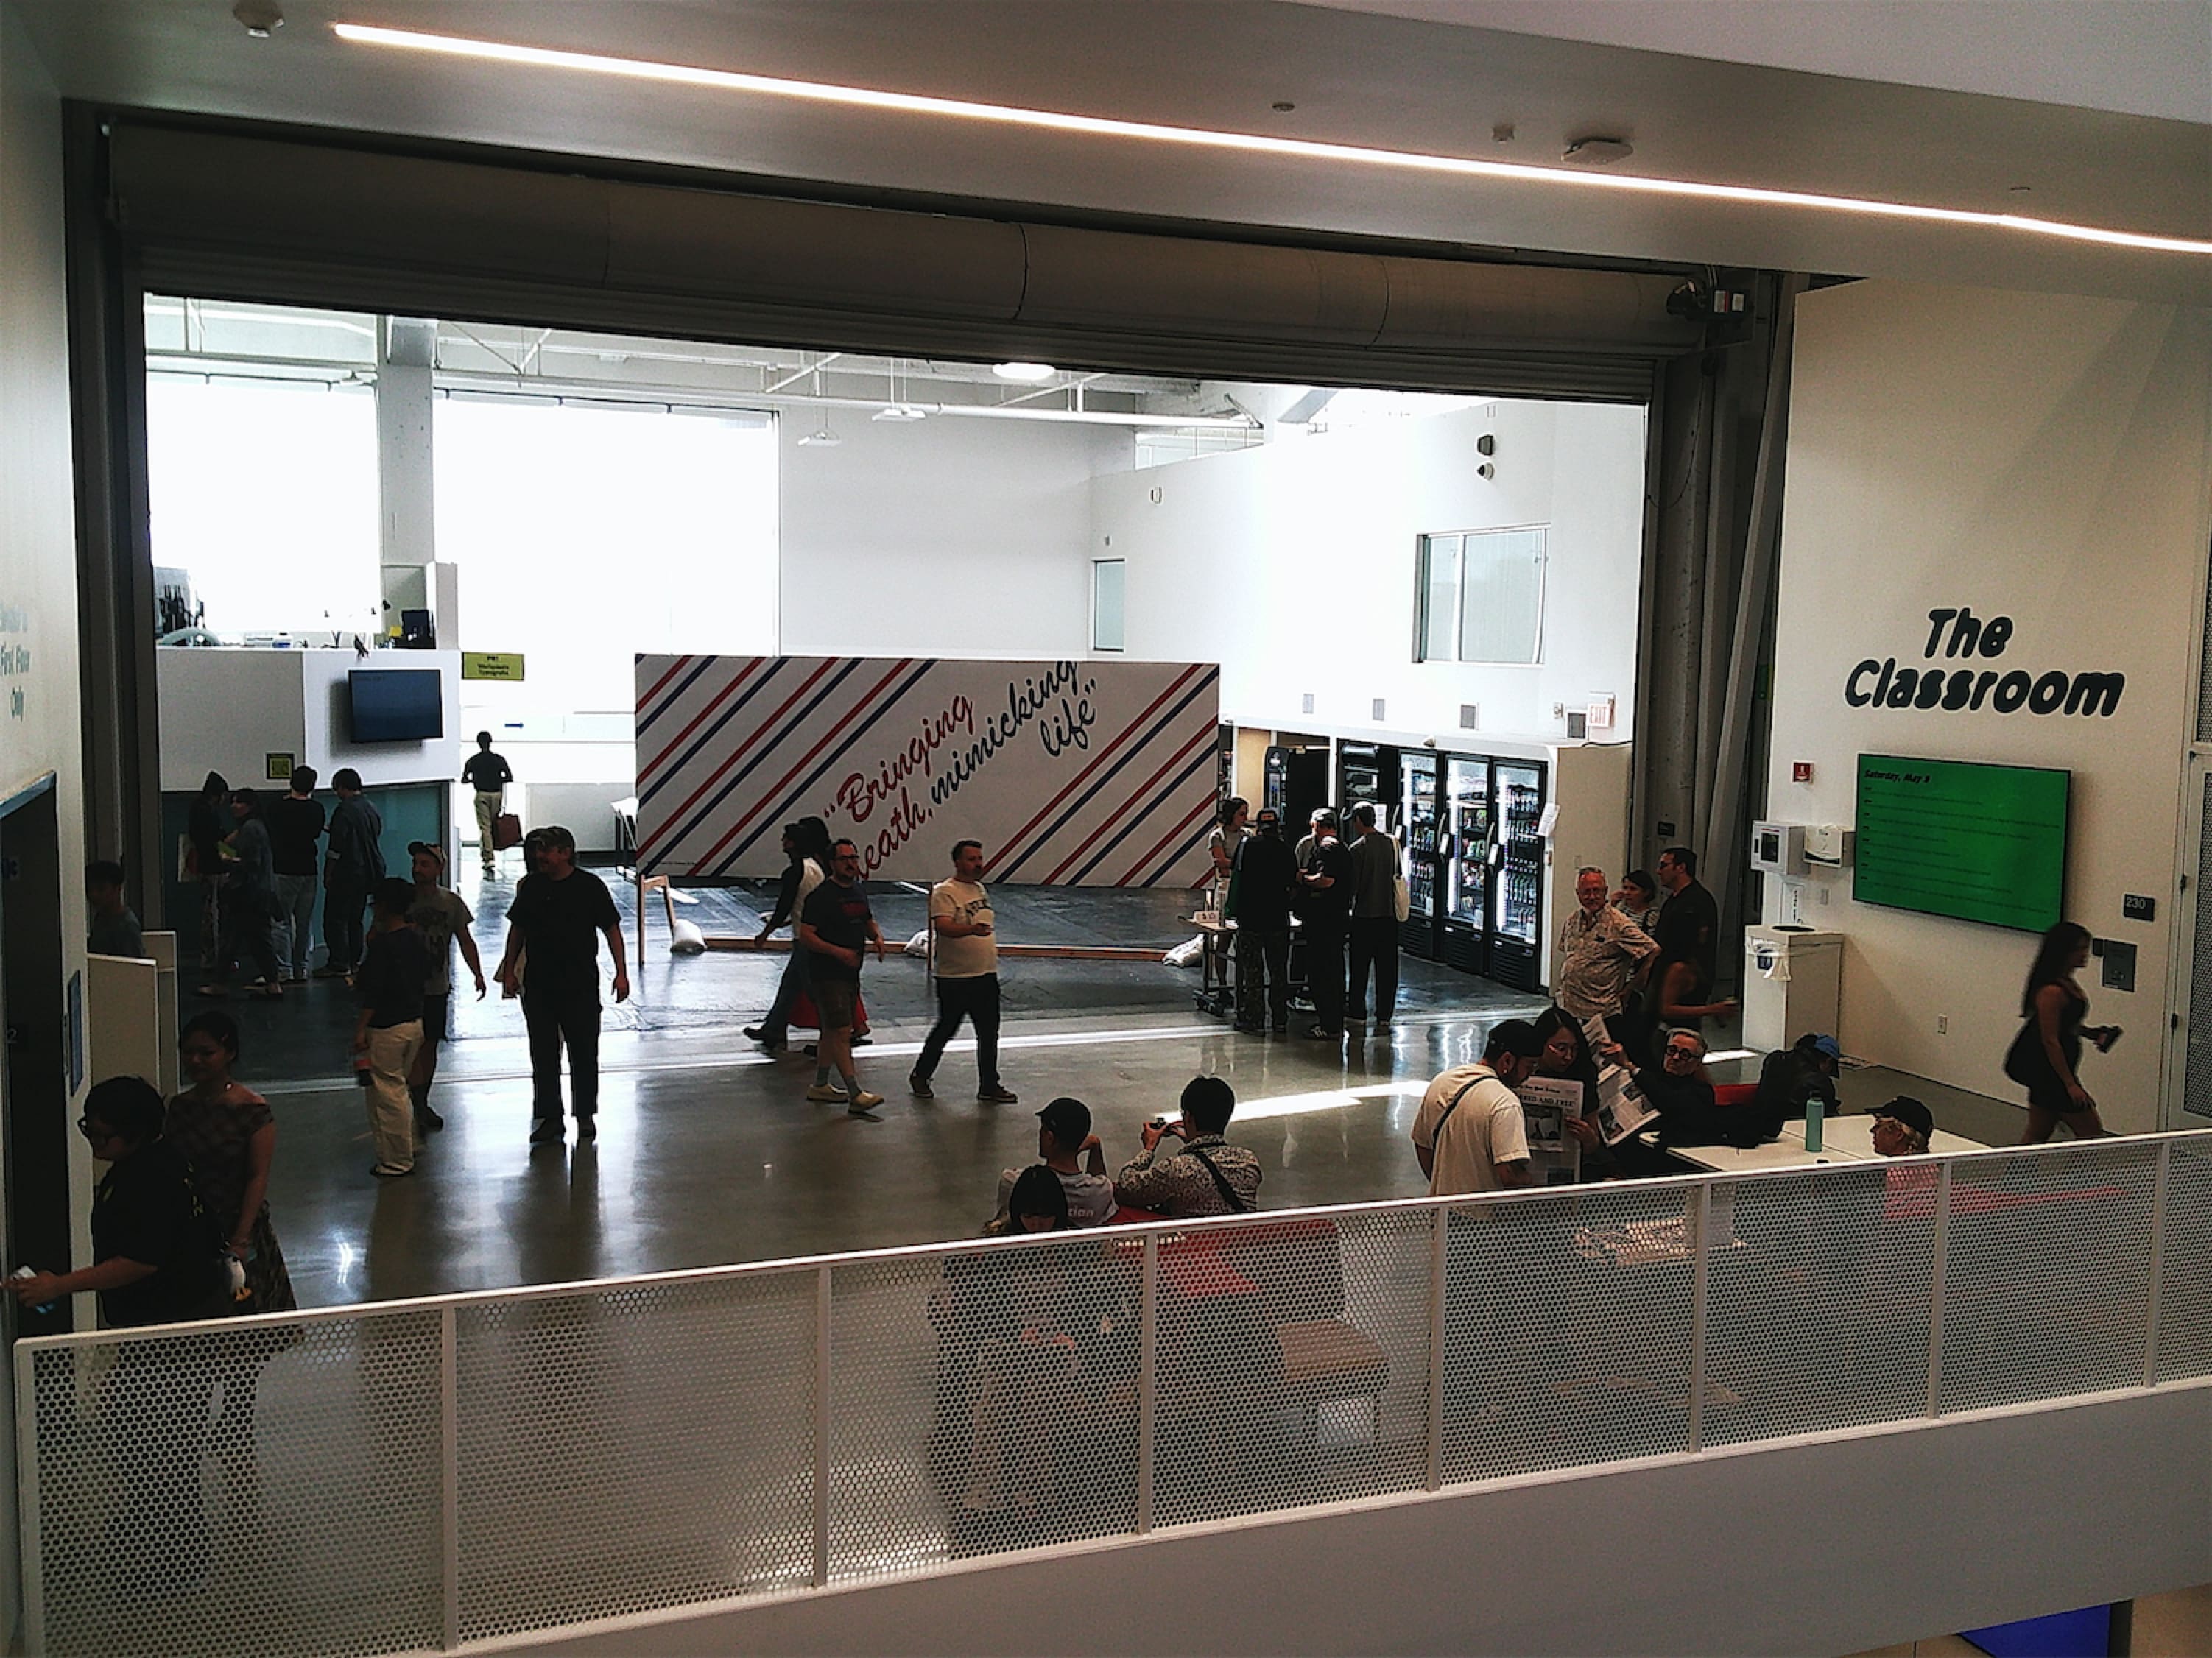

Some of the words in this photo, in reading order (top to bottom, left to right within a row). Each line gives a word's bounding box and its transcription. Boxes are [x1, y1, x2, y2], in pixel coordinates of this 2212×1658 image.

[1924, 607, 2013, 658] The
[1845, 657, 2125, 717] Classroom
[1590, 705, 1607, 724] EXIT
[931, 660, 1077, 805] mimicking
[1864, 769, 1900, 783] Saturday,
[1903, 773, 1922, 784] May
[2125, 896, 2146, 909] 230
